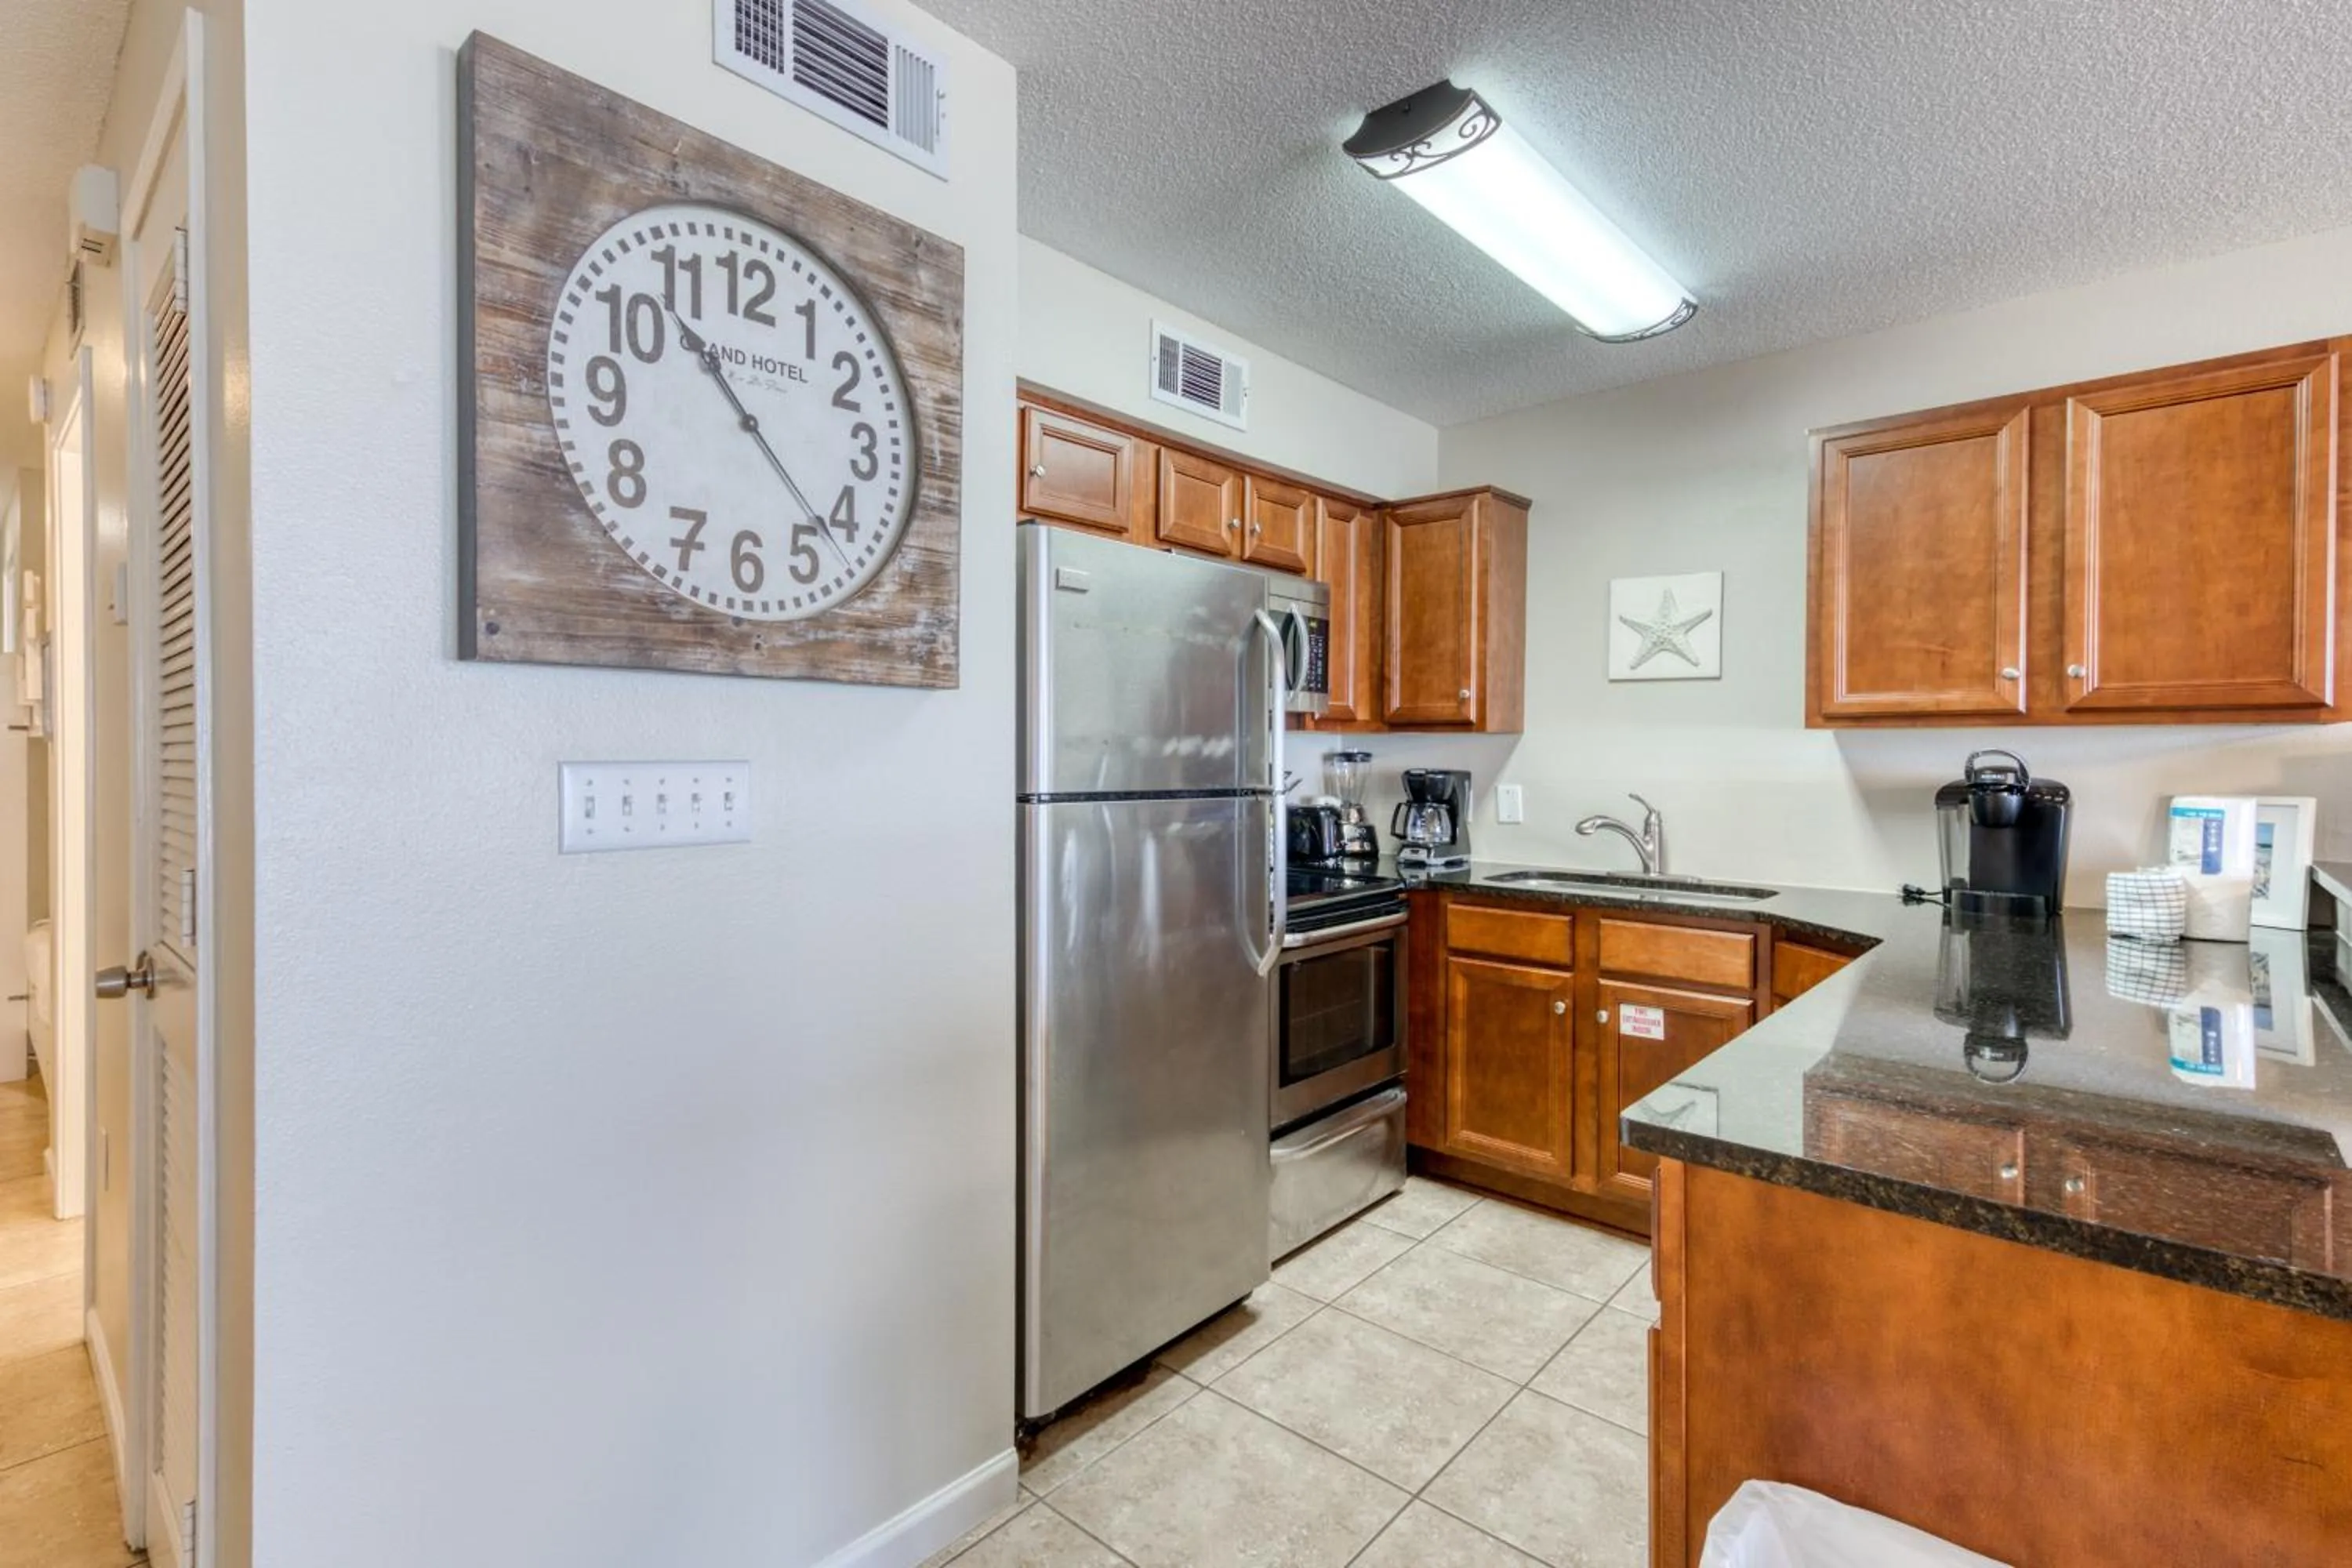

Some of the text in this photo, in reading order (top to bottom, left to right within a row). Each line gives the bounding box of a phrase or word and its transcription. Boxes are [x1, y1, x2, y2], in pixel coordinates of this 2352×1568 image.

[652, 245, 701, 320] 11
[716, 250, 775, 327] 12
[596, 284, 664, 364] 10
[796, 299, 815, 360] 1
[586, 356, 626, 426] 9
[680, 335, 746, 366] AND
[752, 354, 809, 384] HOTEL
[832, 351, 860, 412] 2
[608, 439, 646, 508] 8
[850, 423, 878, 481] 3
[670, 506, 706, 572] 7
[829, 485, 858, 543] 4
[731, 530, 764, 593] 6
[788, 523, 820, 584] 5
